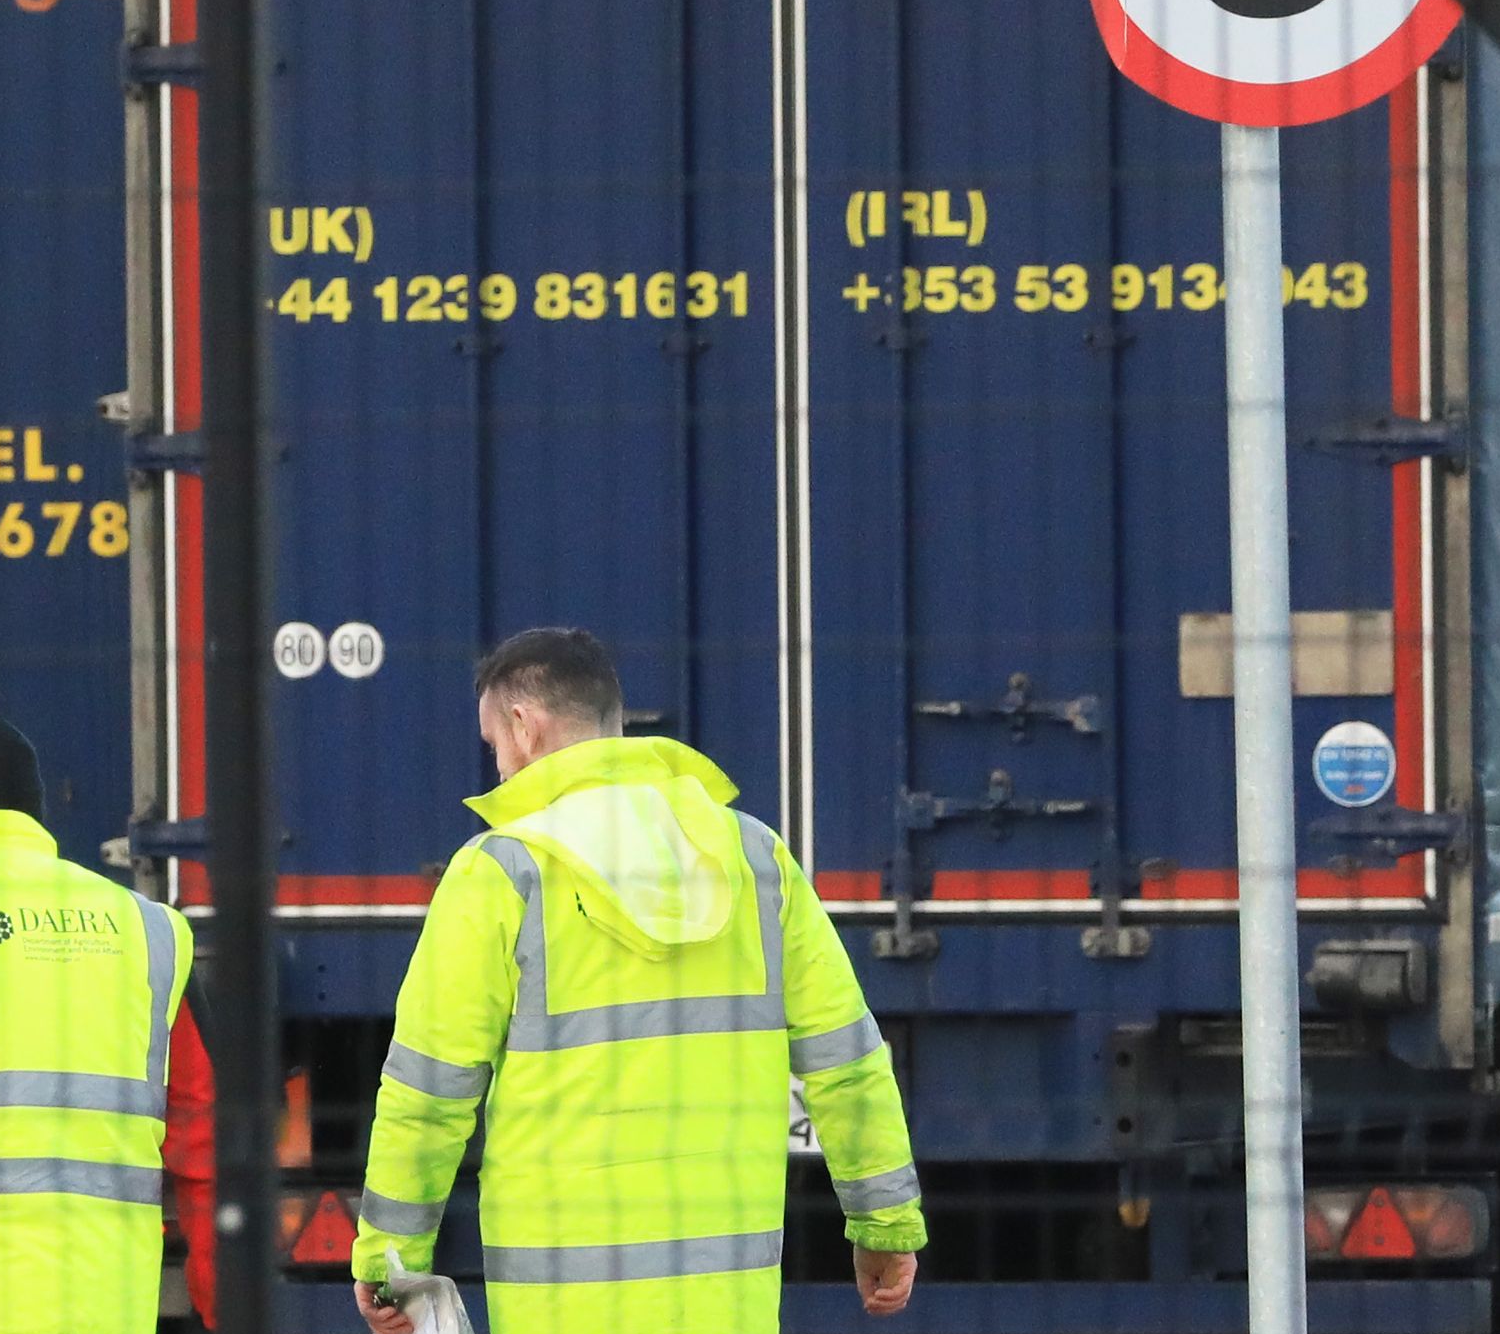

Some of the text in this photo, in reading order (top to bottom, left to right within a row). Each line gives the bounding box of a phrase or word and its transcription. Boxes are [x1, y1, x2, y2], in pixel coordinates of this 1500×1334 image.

[266, 271, 749, 323] 44 1239 831631
[1014, 264, 1090, 313] 53
[1112, 262, 1368, 311] 91343
[281, 634, 374, 666] 80 90
[18, 907, 120, 935] DAERA
